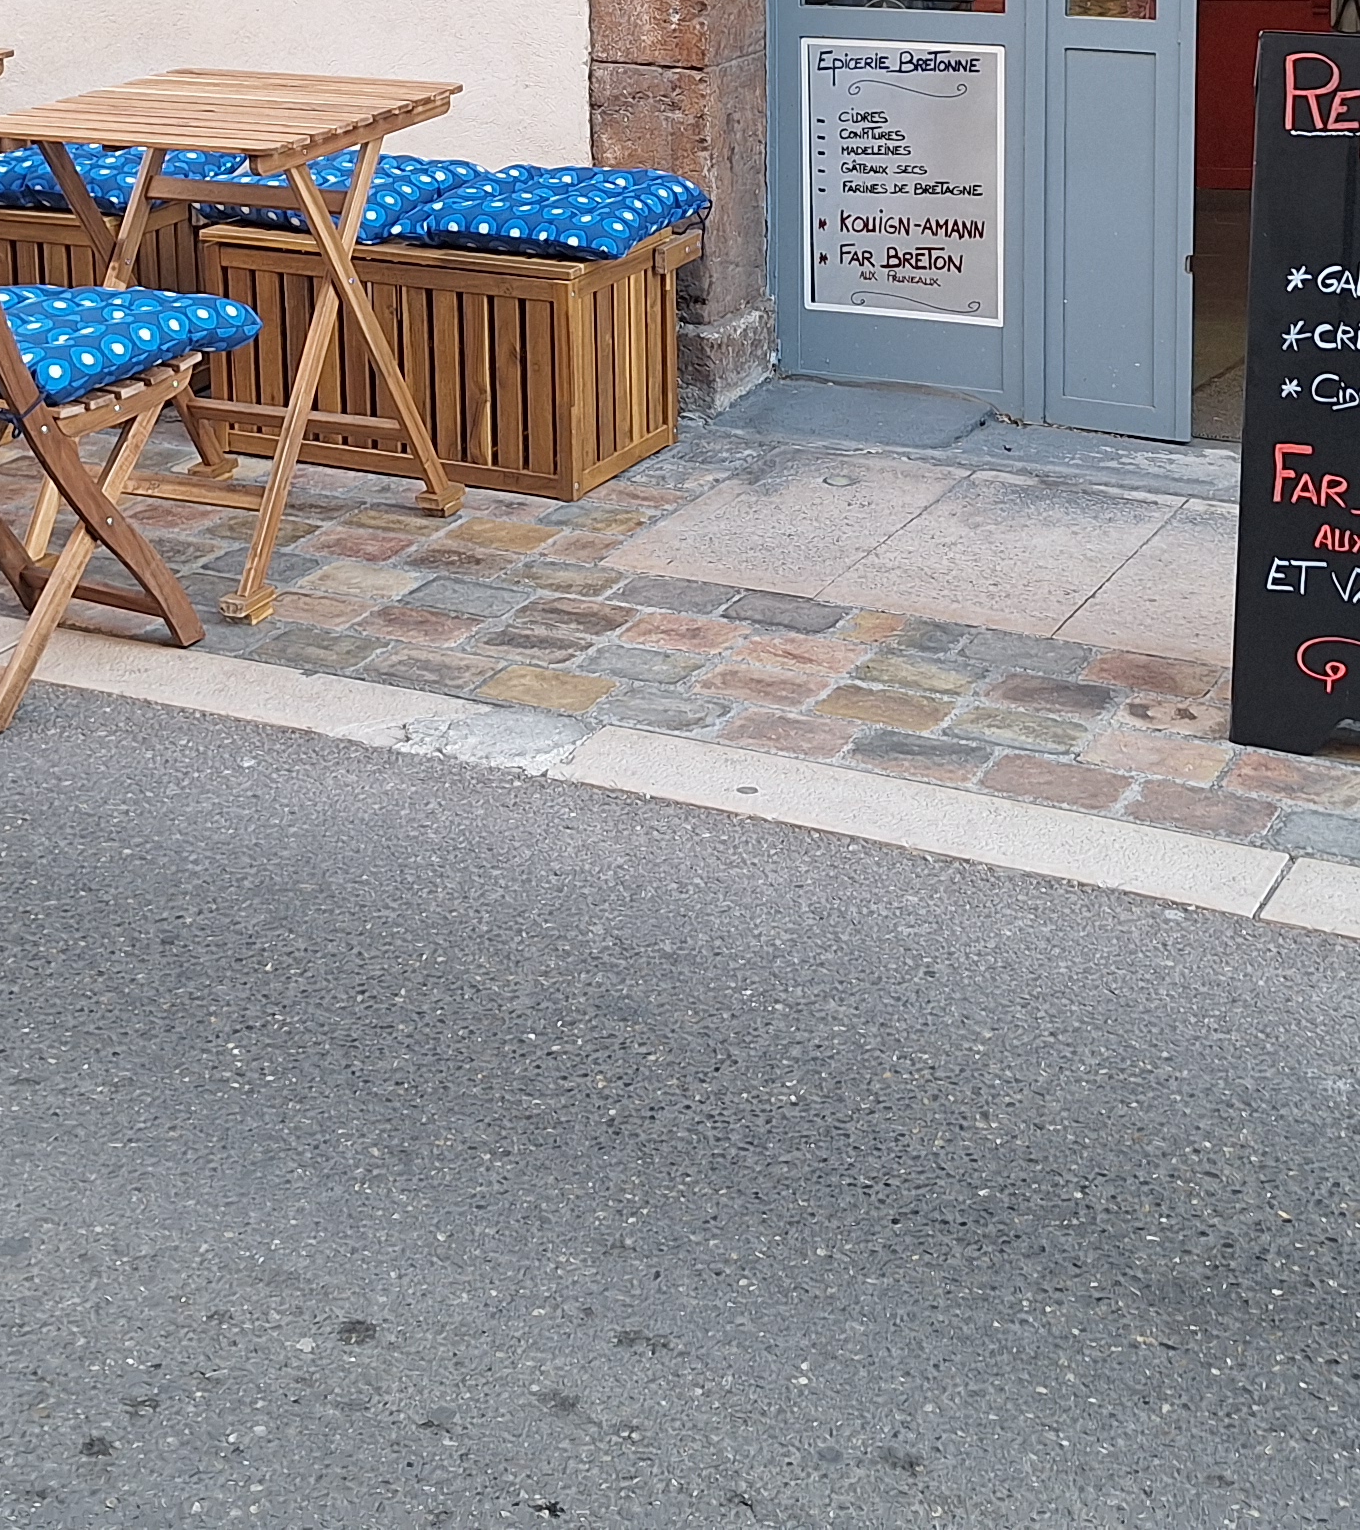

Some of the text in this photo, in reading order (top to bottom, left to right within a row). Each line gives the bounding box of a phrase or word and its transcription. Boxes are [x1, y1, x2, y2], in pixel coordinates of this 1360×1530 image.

[890, 50, 981, 73] BRETONNE
[893, 164, 927, 175] SECS
[890, 182, 909, 194] DE
[914, 181, 983, 197] BRETAGNE
[840, 243, 963, 273] FAR BRETON
[859, 270, 941, 287] AUX PRUNEAUX
[1273, 443, 1347, 508] FAR
[1267, 557, 1327, 594] ET
